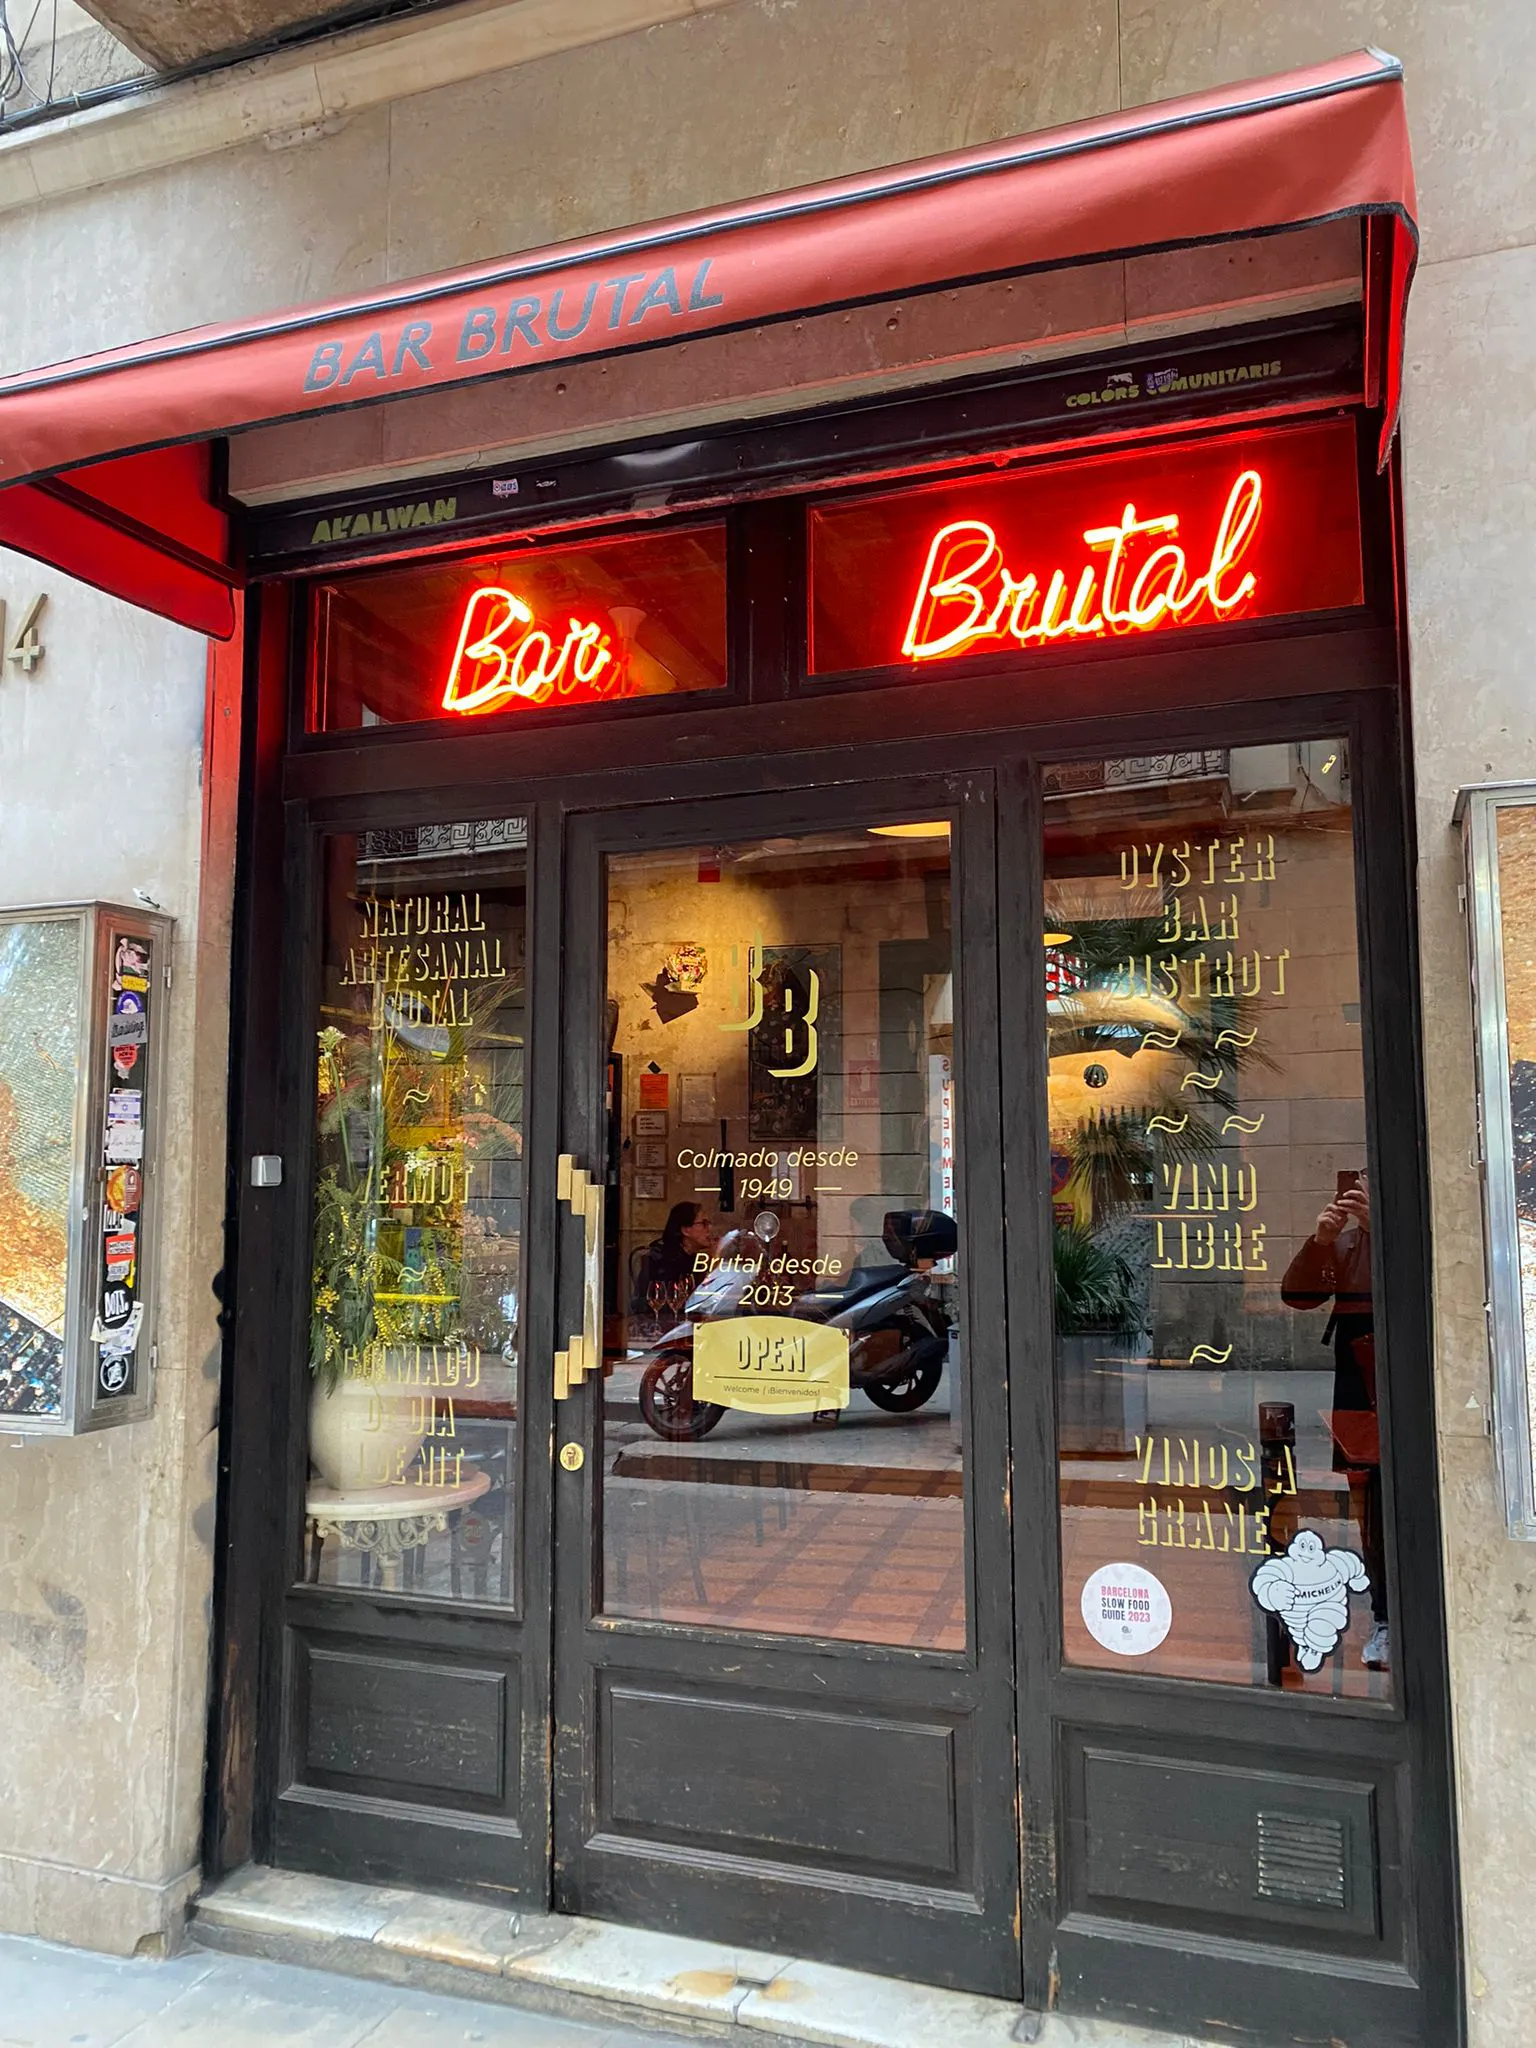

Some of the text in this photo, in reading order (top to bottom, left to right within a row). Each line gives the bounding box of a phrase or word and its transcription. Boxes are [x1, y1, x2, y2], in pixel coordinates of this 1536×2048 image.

[303, 259, 724, 394] BAR BRUTAL
[1066, 385, 1140, 408] COLORS
[901, 470, 1260, 659] Brutal
[0, 592, 48, 673] 4
[442, 586, 612, 712] Bar
[1120, 834, 1277, 890] OYSTER
[359, 892, 486, 939] NATURAL
[1157, 893, 1240, 944] BAR
[338, 938, 507, 986] ARTESANAL
[1112, 948, 1291, 1001] BISTROT
[367, 987, 474, 1031] BRUTAL
[677, 1147, 779, 1169] Colmado
[787, 1146, 859, 1168] desde
[740, 1178, 793, 1199] 1949
[1162, 1162, 1258, 1212] VINO
[693, 1252, 842, 1275] Brutal desde
[1150, 1220, 1268, 1271] LIBRE
[739, 1284, 795, 1306] 2013
[737, 1335, 806, 1373] OPEN
[723, 1384, 760, 1394] Welcome
[1135, 1435, 1298, 1496] VINOS A
[1136, 1496, 1285, 1557] GRANE
[1101, 1585, 1150, 1600] BARCELONA
[1101, 1597, 1150, 1611] SLOW FOOD
[1296, 1580, 1342, 1600] MICHELIN
[1101, 1608, 1151, 1623] GUIDE 2023
